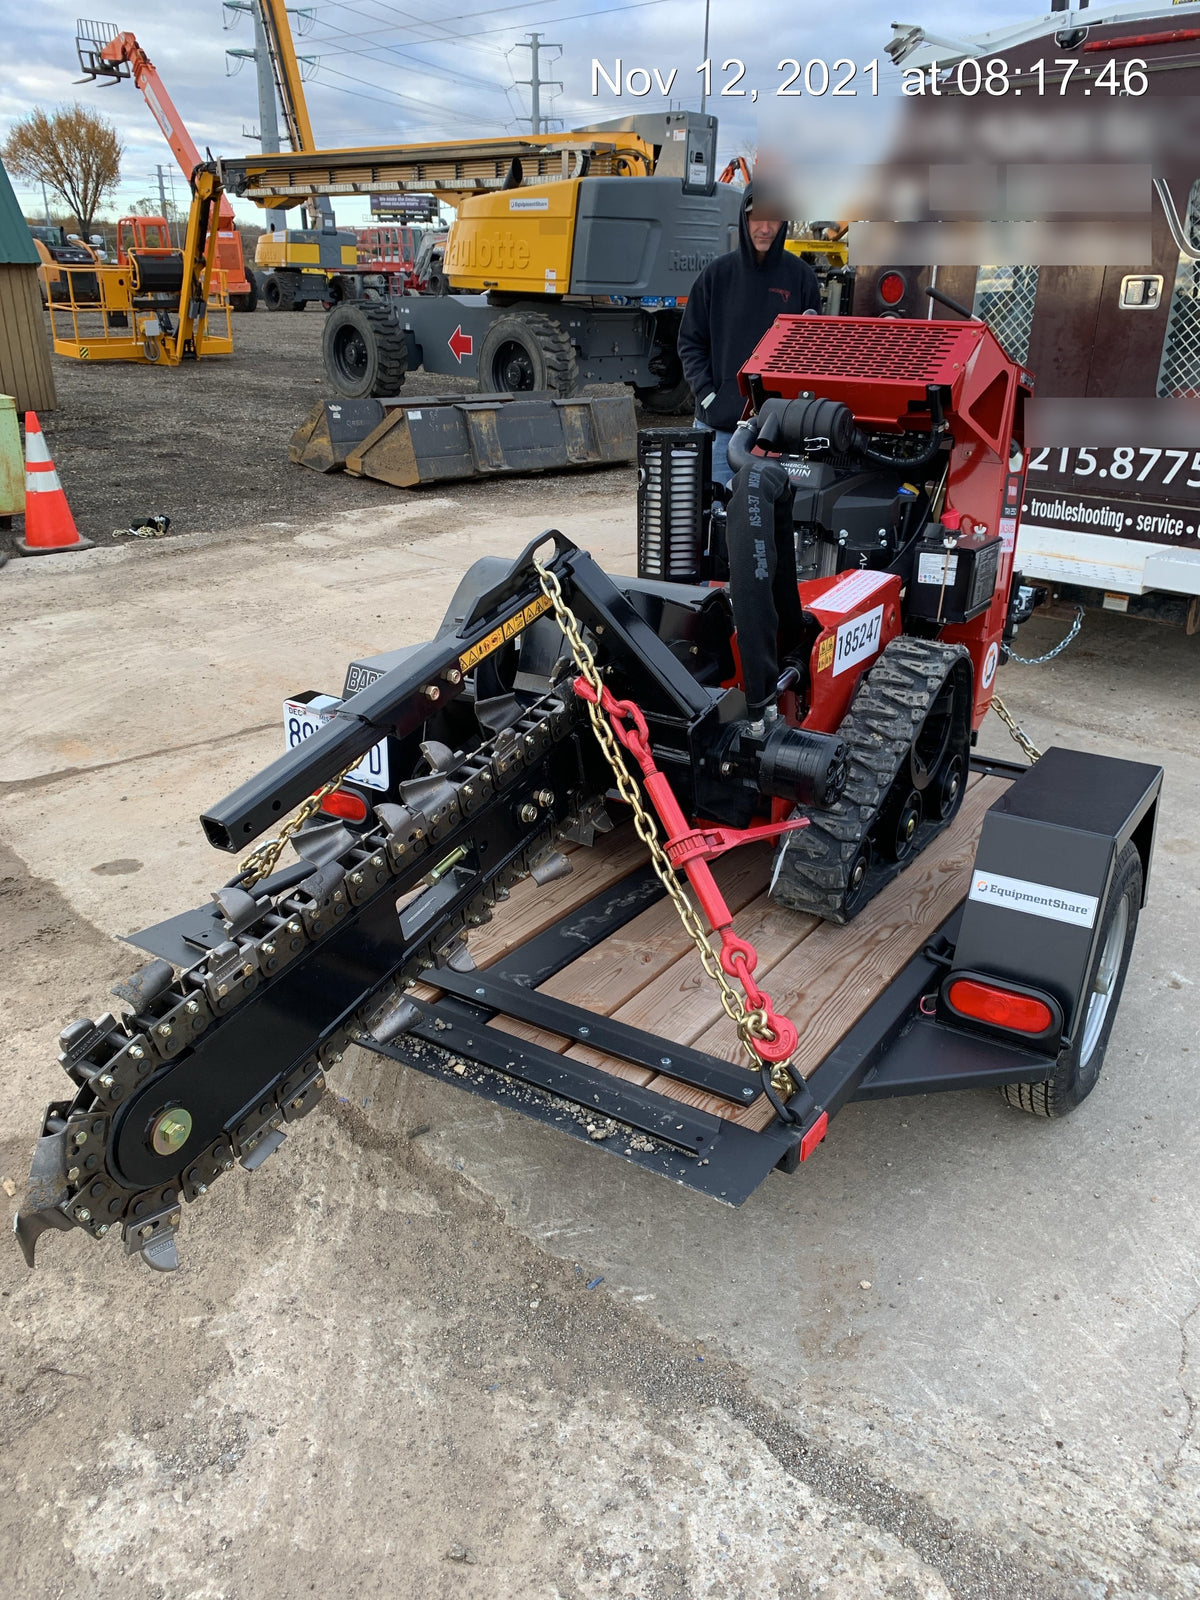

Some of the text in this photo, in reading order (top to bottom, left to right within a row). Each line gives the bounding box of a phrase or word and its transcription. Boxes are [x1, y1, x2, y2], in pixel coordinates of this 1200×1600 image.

[443, 231, 531, 270] Haulotte
[748, 494, 761, 527] AS-B-37
[1031, 498, 1183, 536] troubleshooting service
[754, 539, 768, 580] Parker
[838, 615, 881, 661] 185247
[288, 707, 303, 716] DEC
[990, 884, 1088, 915] EquipmentShare
